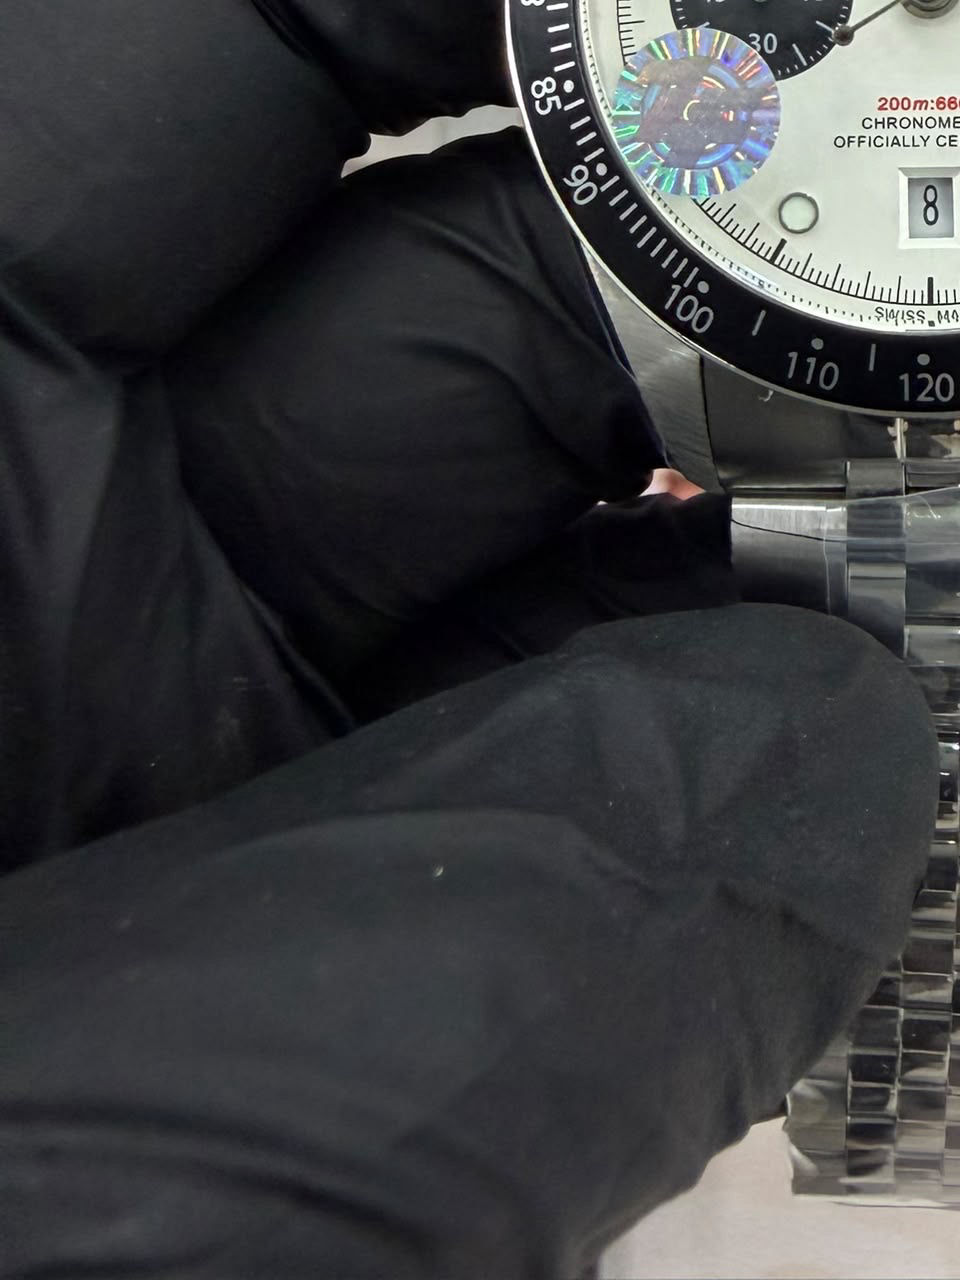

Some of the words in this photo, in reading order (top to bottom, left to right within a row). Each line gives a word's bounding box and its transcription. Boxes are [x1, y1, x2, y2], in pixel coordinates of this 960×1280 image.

[748, 33, 778, 54] 30
[530, 76, 562, 116] 85
[833, 135, 931, 149] OFFICIALLY
[562, 164, 598, 206] 90
[923, 184, 939, 226] 8
[664, 284, 714, 333] 100
[787, 351, 839, 391] 110
[899, 373, 954, 402] 120
